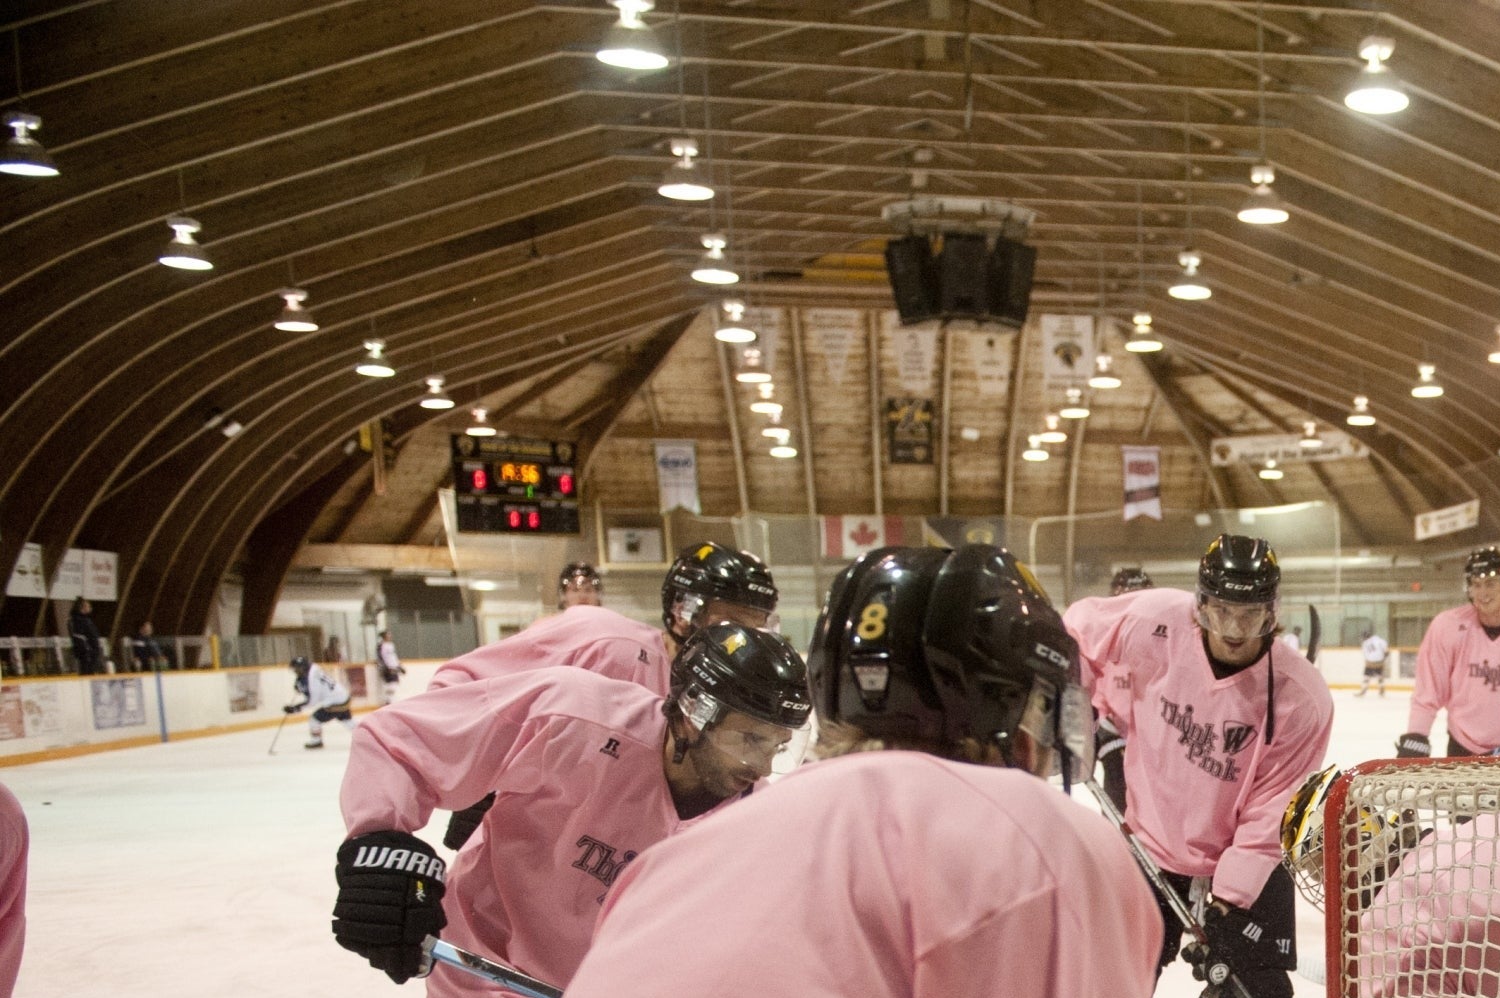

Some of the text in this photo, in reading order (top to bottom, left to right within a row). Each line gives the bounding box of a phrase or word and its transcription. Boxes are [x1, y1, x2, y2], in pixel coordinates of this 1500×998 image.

[748, 583, 774, 595] CCM
[1225, 582, 1254, 591] CCM
[857, 603, 888, 640] 8
[1035, 643, 1070, 670] CCM
[692, 665, 717, 686] CCM
[782, 700, 810, 711] CCM
[1160, 696, 1218, 750] Think
[1186, 740, 1242, 783] Pink
